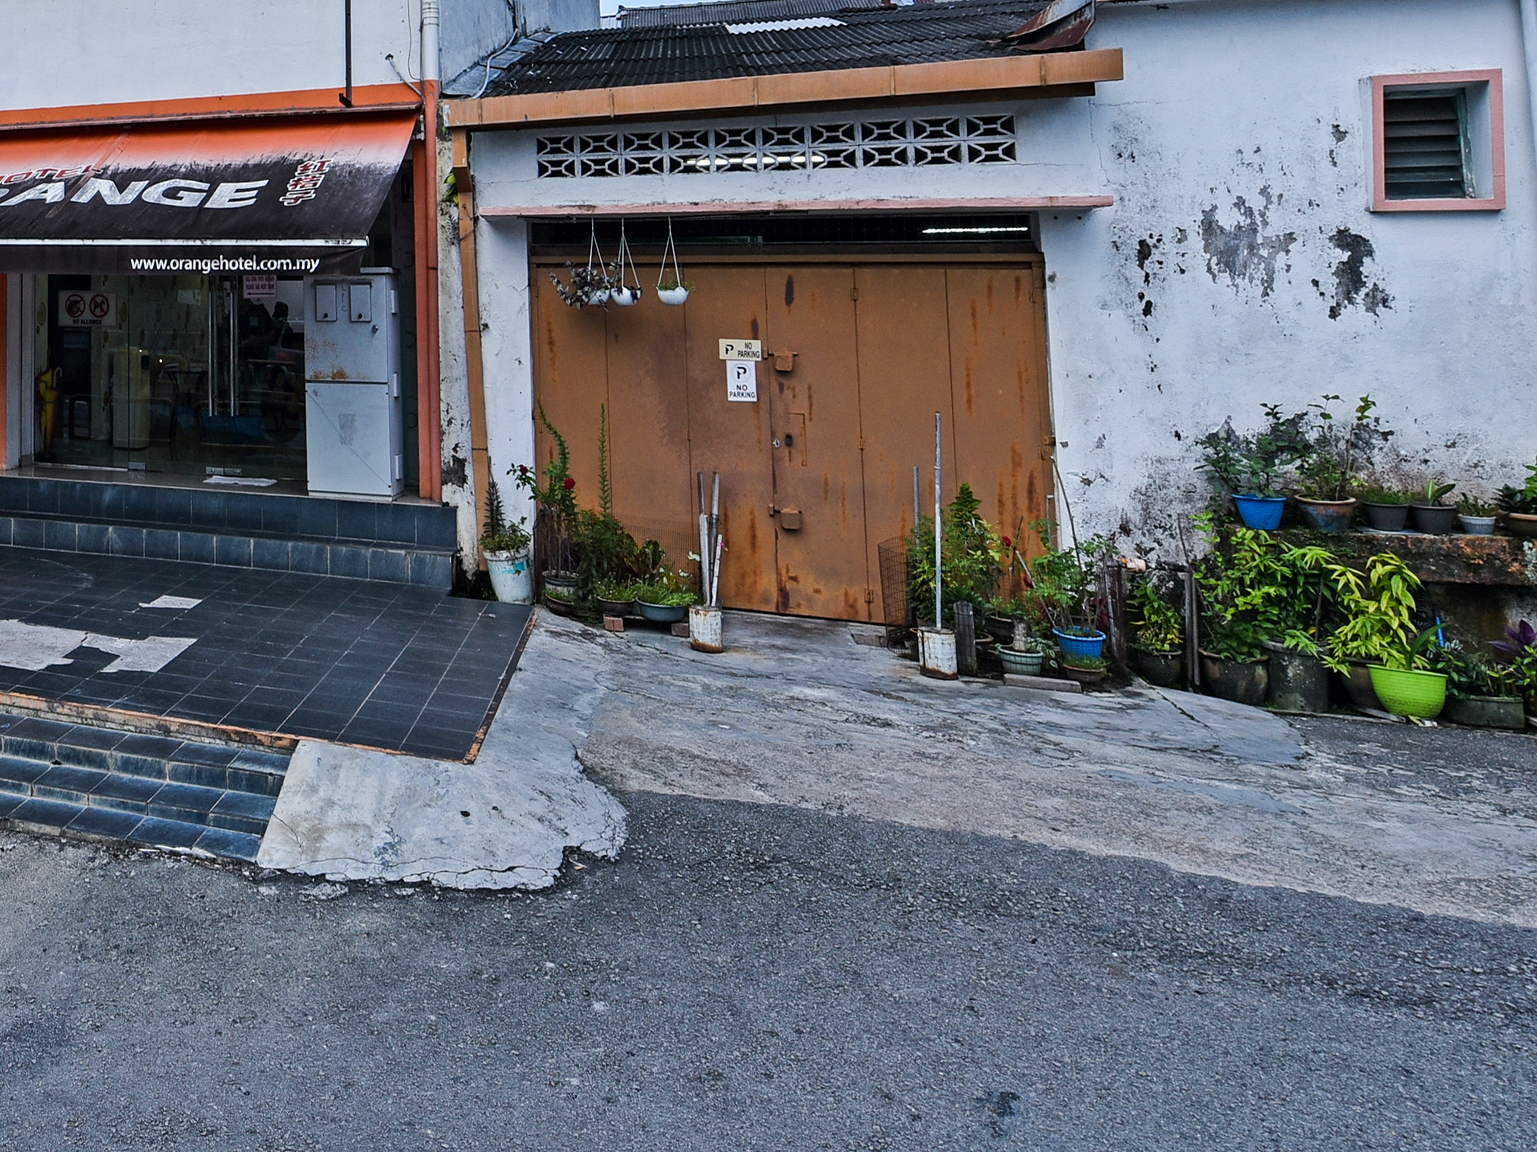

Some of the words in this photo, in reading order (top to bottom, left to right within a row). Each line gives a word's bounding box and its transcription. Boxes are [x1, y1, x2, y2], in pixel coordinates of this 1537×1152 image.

[130, 254, 320, 275] www.orangehotel.com.my
[744, 342, 753, 350] NO
[737, 350, 760, 359] PARKING
[736, 384, 748, 392] NO
[729, 391, 756, 399] PARKING
